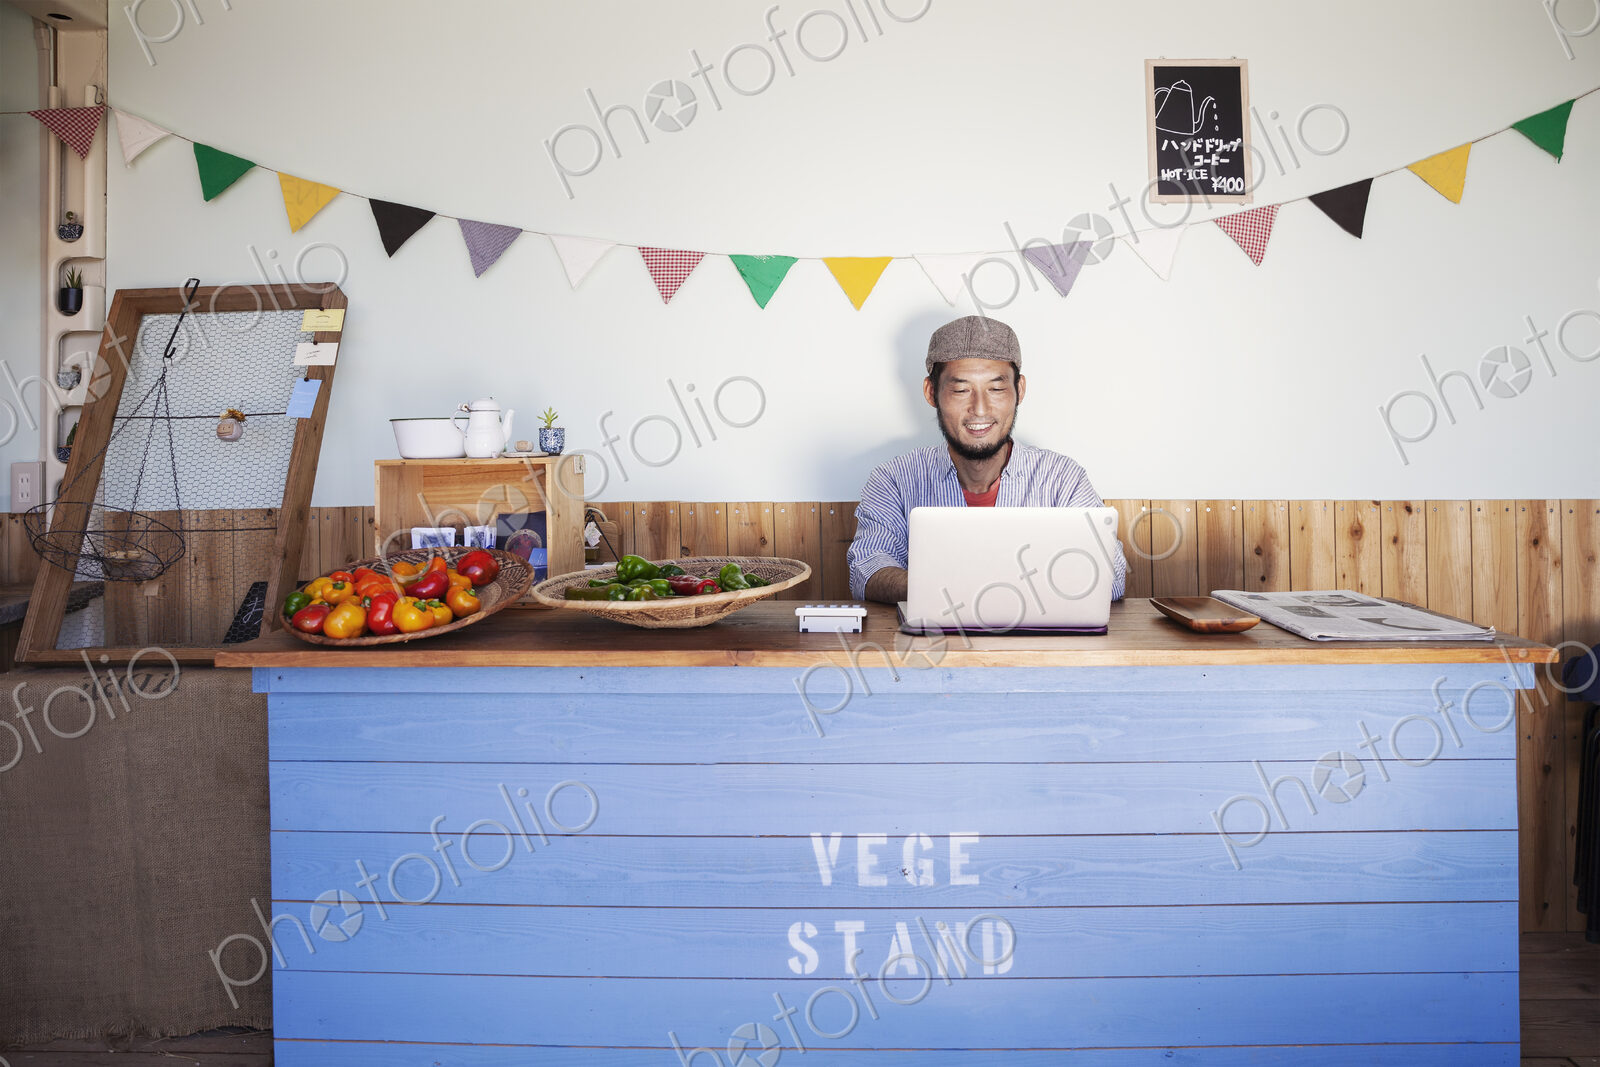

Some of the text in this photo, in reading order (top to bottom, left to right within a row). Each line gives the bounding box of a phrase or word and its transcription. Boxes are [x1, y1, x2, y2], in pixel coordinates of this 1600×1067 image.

[1161, 137, 1242, 153] ハンドドリップ
[1193, 153, 1230, 166] コーヒー
[1210, 176, 1244, 193] ¥400
[810, 831, 980, 887] VEGE
[787, 920, 1014, 976] STAND
